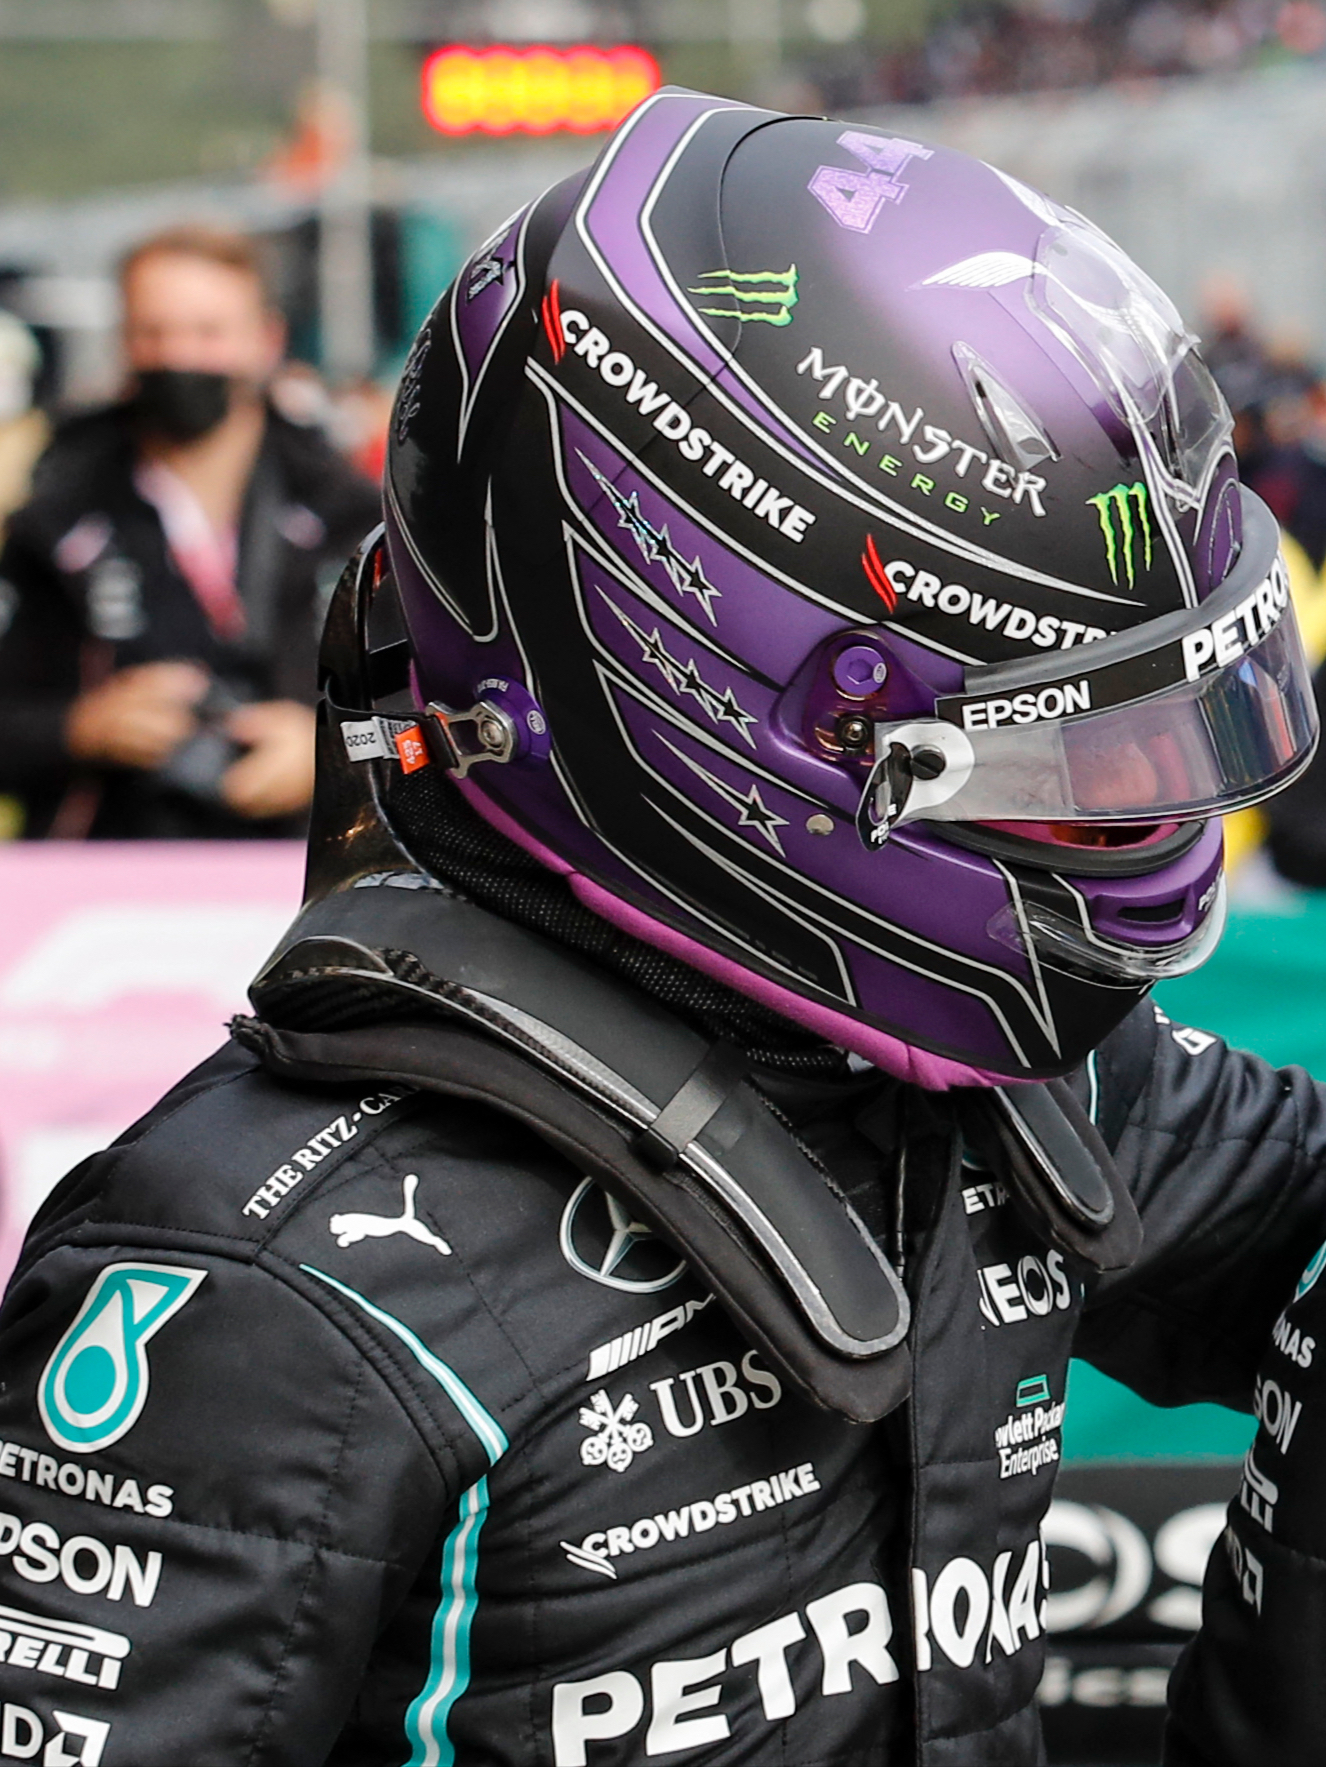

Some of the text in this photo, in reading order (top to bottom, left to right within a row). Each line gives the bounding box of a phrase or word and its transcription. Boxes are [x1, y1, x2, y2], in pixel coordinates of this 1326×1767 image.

[559, 309, 817, 543] CROWDSTRIKE
[796, 346, 1048, 518] MONSTER
[811, 410, 1001, 527] ENERGY
[1181, 553, 1290, 683] PETRO
[961, 680, 1092, 731] EPSON
[241, 1163, 304, 1220] THE
[649, 1350, 782, 1438] UBS
[0, 1440, 174, 1518] ETRONAS
[998, 1435, 1060, 1479] Enterprise
[581, 1462, 822, 1560] CROWDSTRIKE
